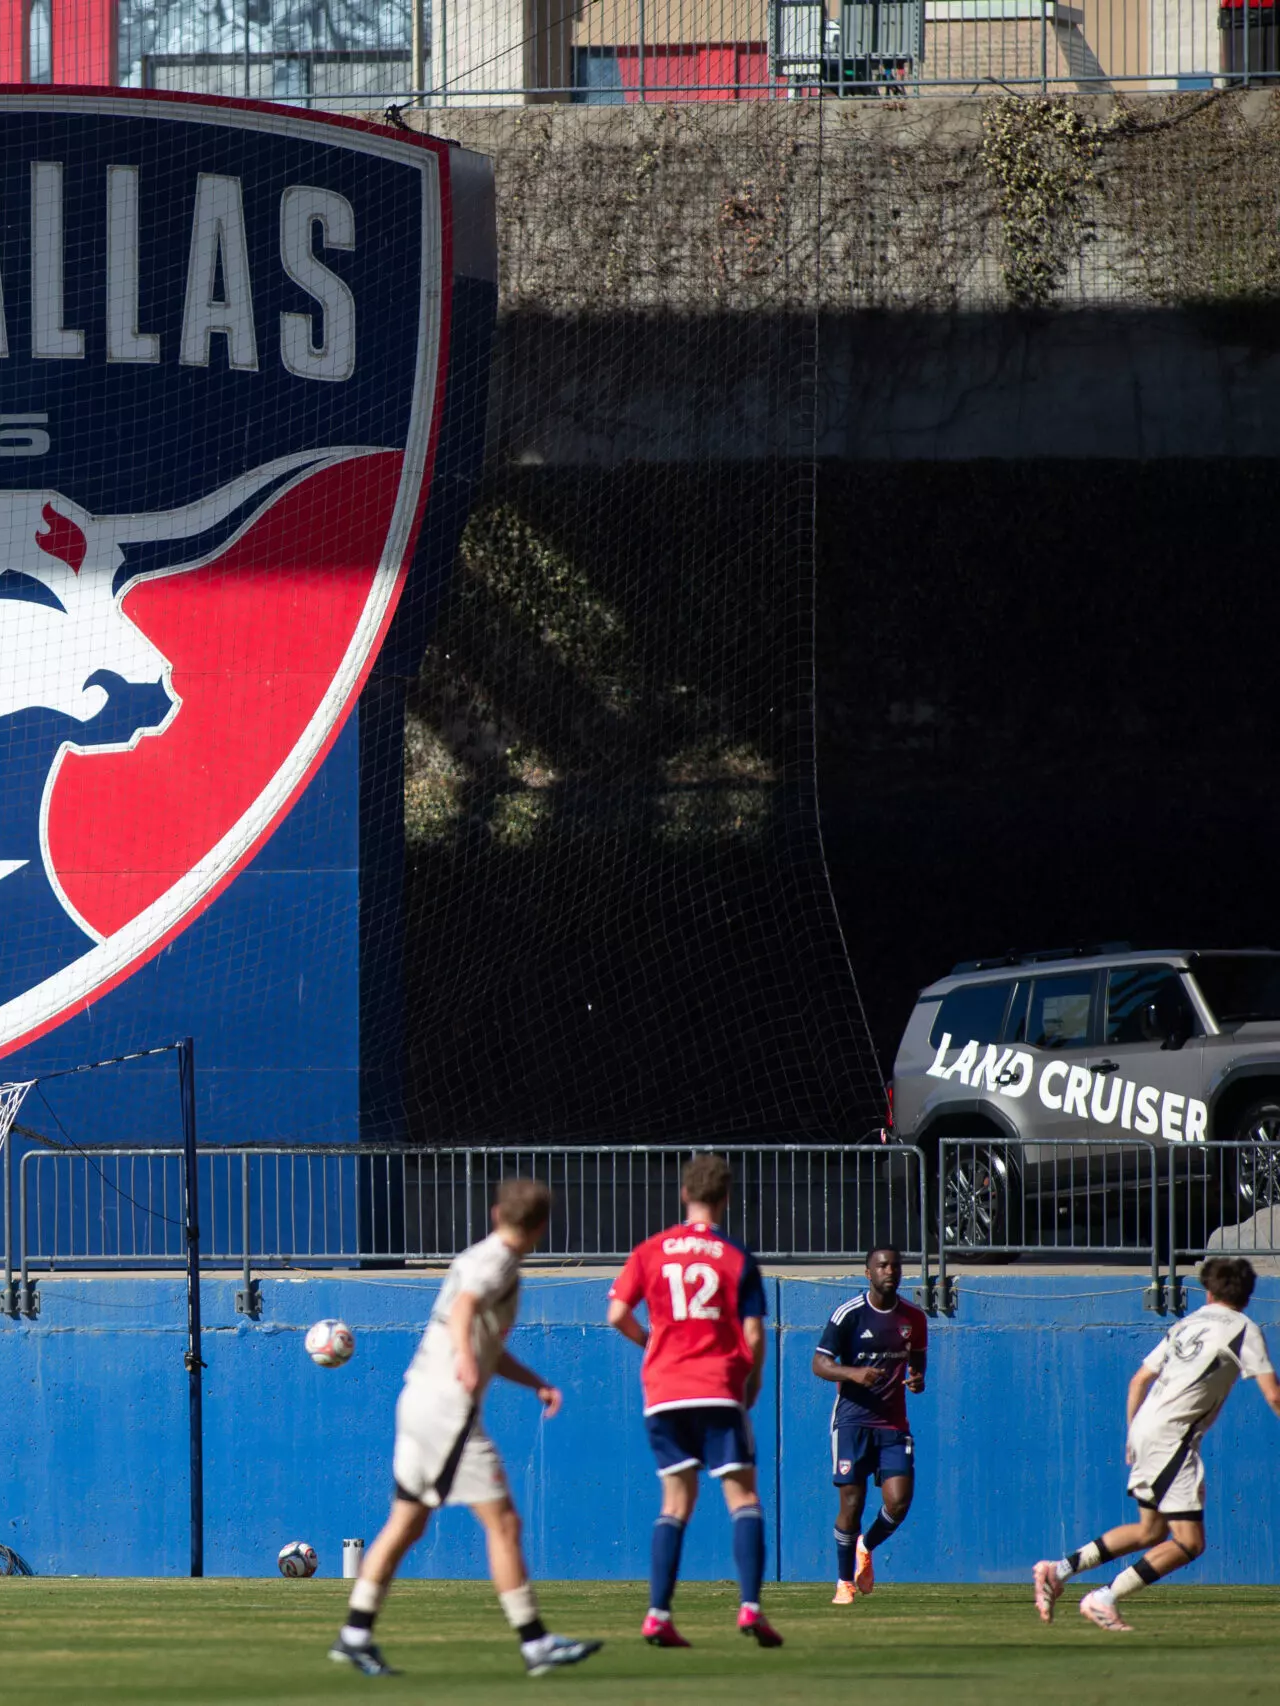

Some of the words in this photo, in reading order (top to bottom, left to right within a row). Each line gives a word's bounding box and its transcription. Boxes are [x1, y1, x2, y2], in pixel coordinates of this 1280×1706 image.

[925, 1032, 1034, 1098] LAND
[1039, 1060, 1208, 1142] CRUISER
[662, 1262, 721, 1322] 12
